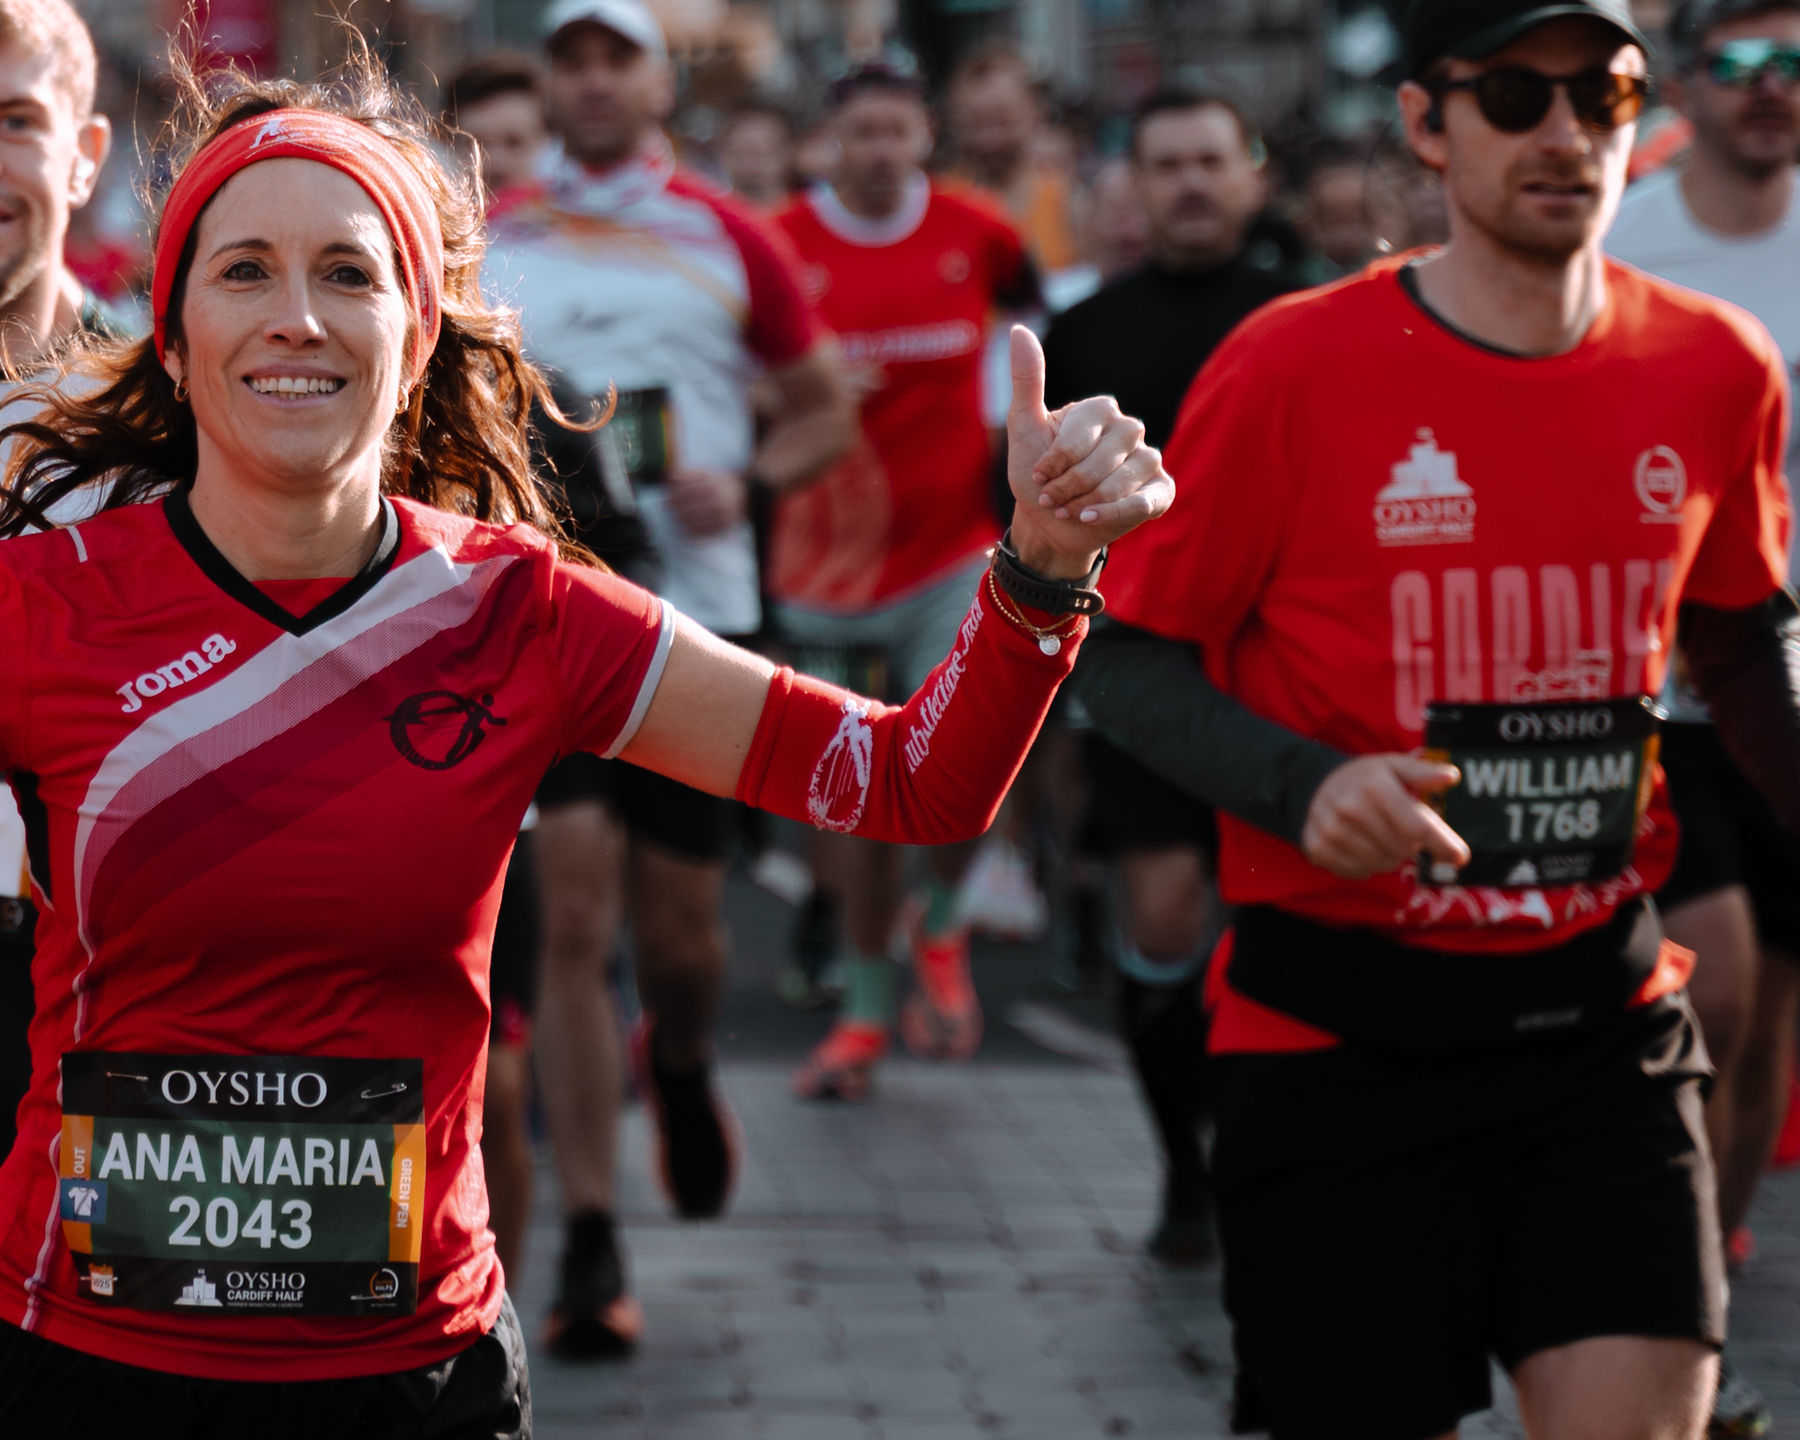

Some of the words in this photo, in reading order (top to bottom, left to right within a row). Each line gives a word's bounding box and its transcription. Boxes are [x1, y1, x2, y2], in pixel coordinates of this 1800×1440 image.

[1499, 709, 1613, 741] OYSHO
[1464, 751, 1634, 798] WILLIAM
[1504, 799, 1601, 843] 1768
[161, 1071, 328, 1107] OYSHO
[99, 1132, 207, 1183] ANA
[221, 1135, 386, 1186] MARIA
[168, 1196, 313, 1250] 2043
[226, 1271, 306, 1289] OYSHO
[227, 1290, 273, 1301] CARDIFF
[275, 1290, 304, 1301] HALF
